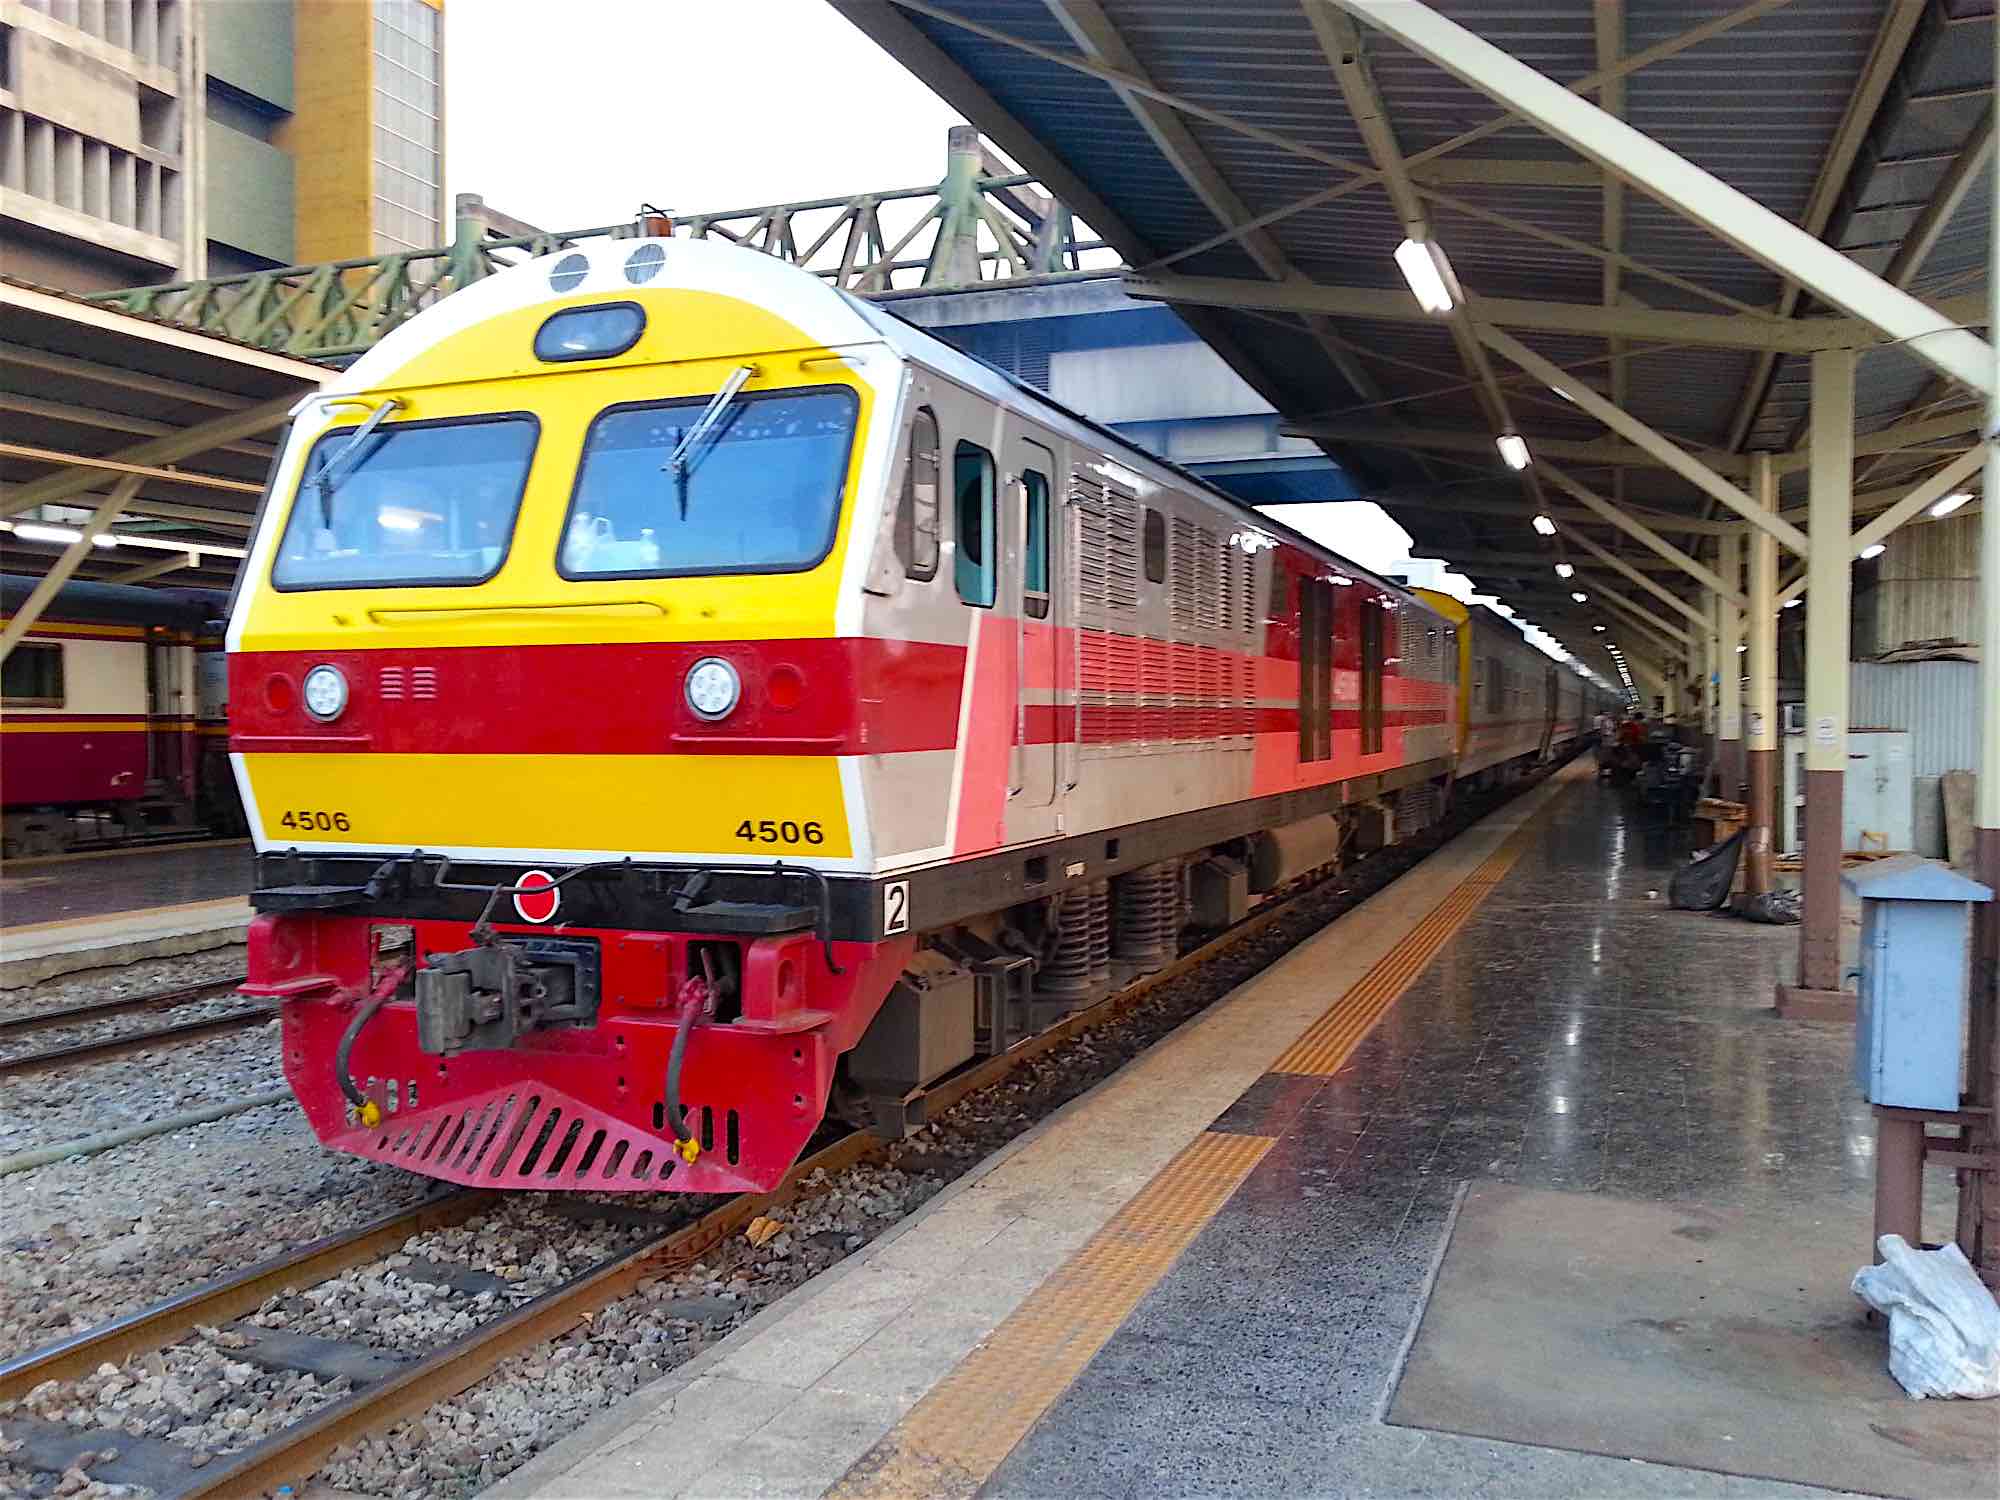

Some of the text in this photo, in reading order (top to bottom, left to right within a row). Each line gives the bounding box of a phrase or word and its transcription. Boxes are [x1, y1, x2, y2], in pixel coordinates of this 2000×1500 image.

[281, 811, 350, 832] 4506
[735, 820, 824, 844] 4506
[889, 885, 905, 930] 2
